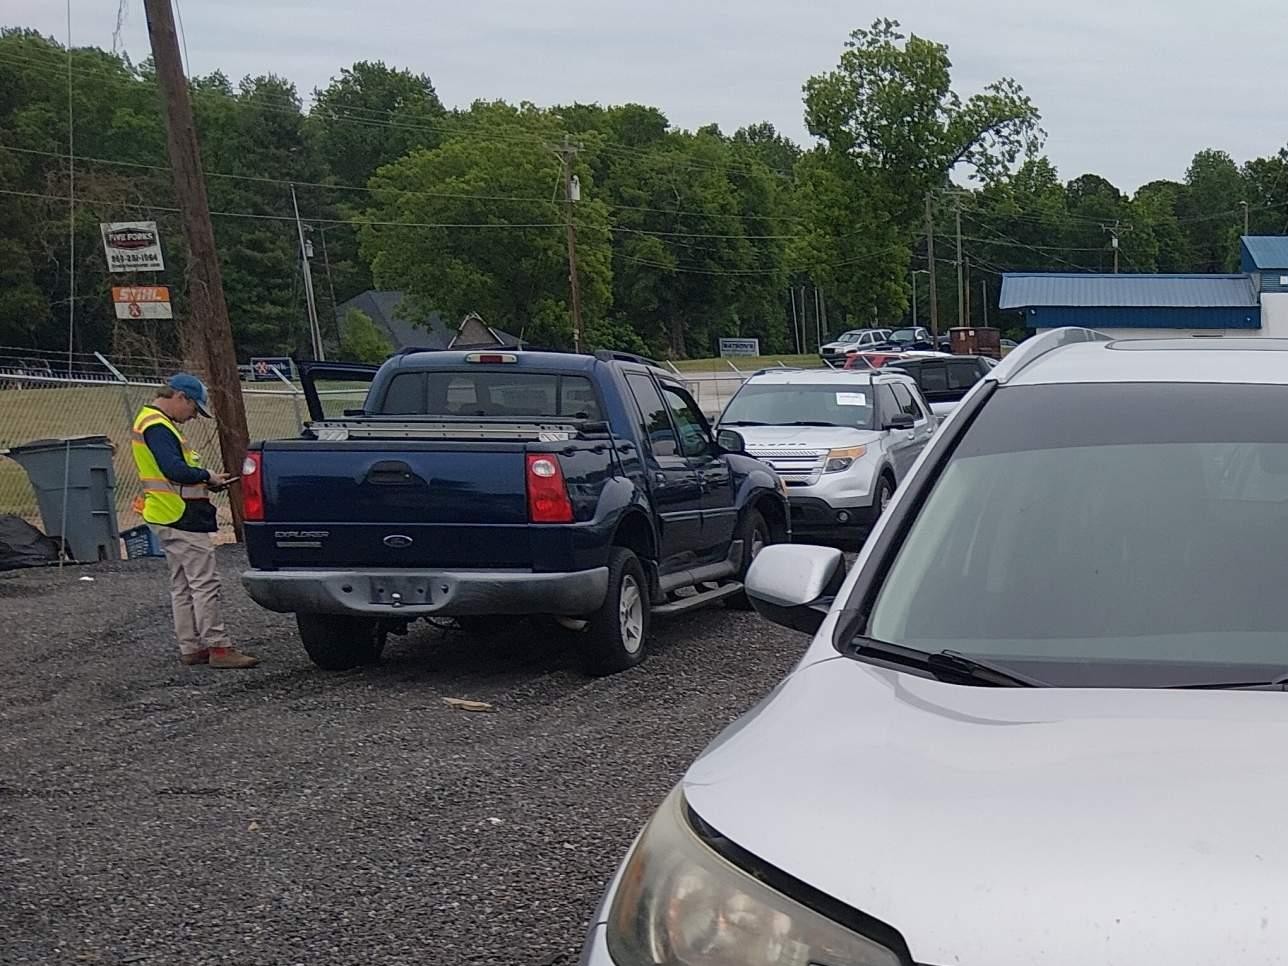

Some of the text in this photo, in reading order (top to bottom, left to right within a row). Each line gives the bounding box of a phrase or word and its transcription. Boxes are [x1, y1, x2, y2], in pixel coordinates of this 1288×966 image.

[109, 232, 153, 241] FIVE FORKS
[119, 287, 162, 300] STIHL
